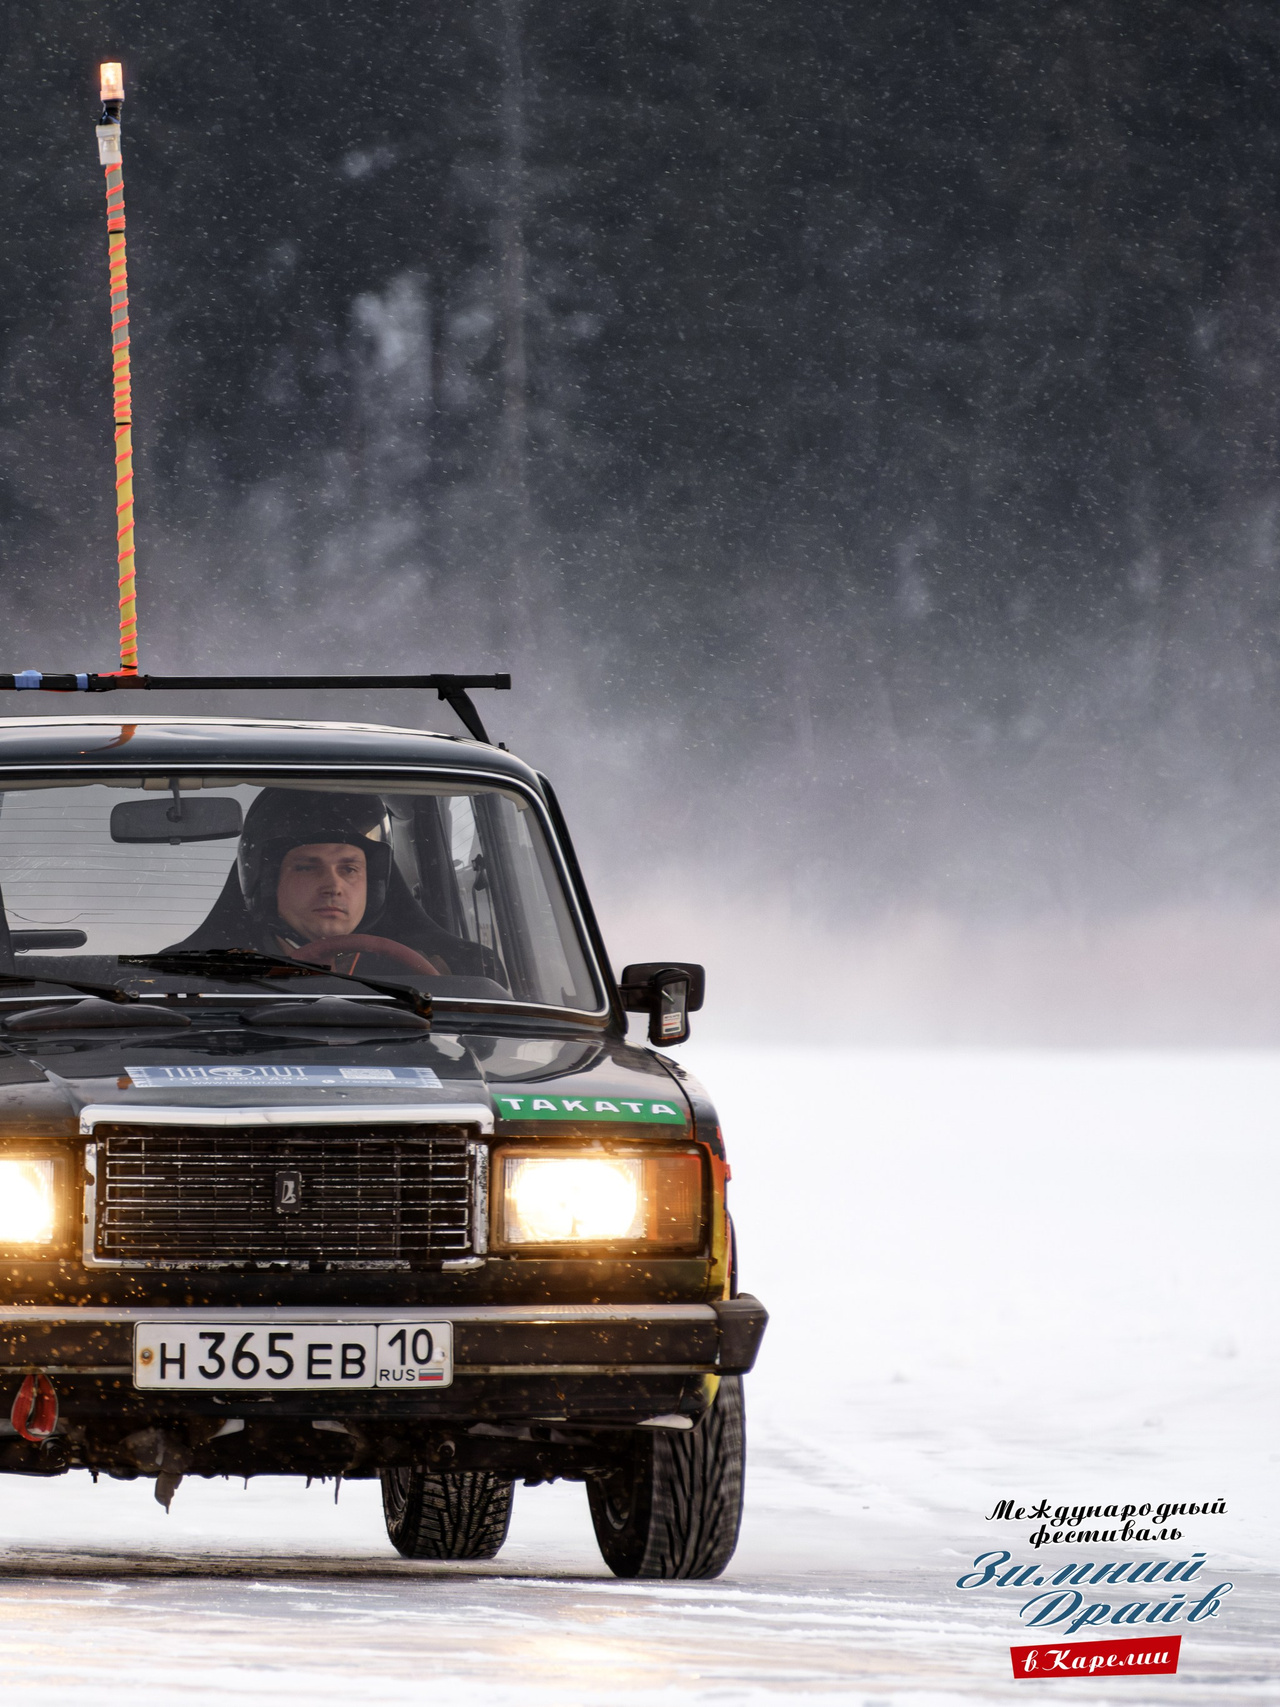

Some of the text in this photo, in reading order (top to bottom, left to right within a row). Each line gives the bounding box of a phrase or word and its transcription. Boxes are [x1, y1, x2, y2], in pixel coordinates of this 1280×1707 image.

[501, 1098, 677, 1115] TAKATA
[388, 1328, 434, 1366] 10
[379, 1369, 416, 1381] RUS
